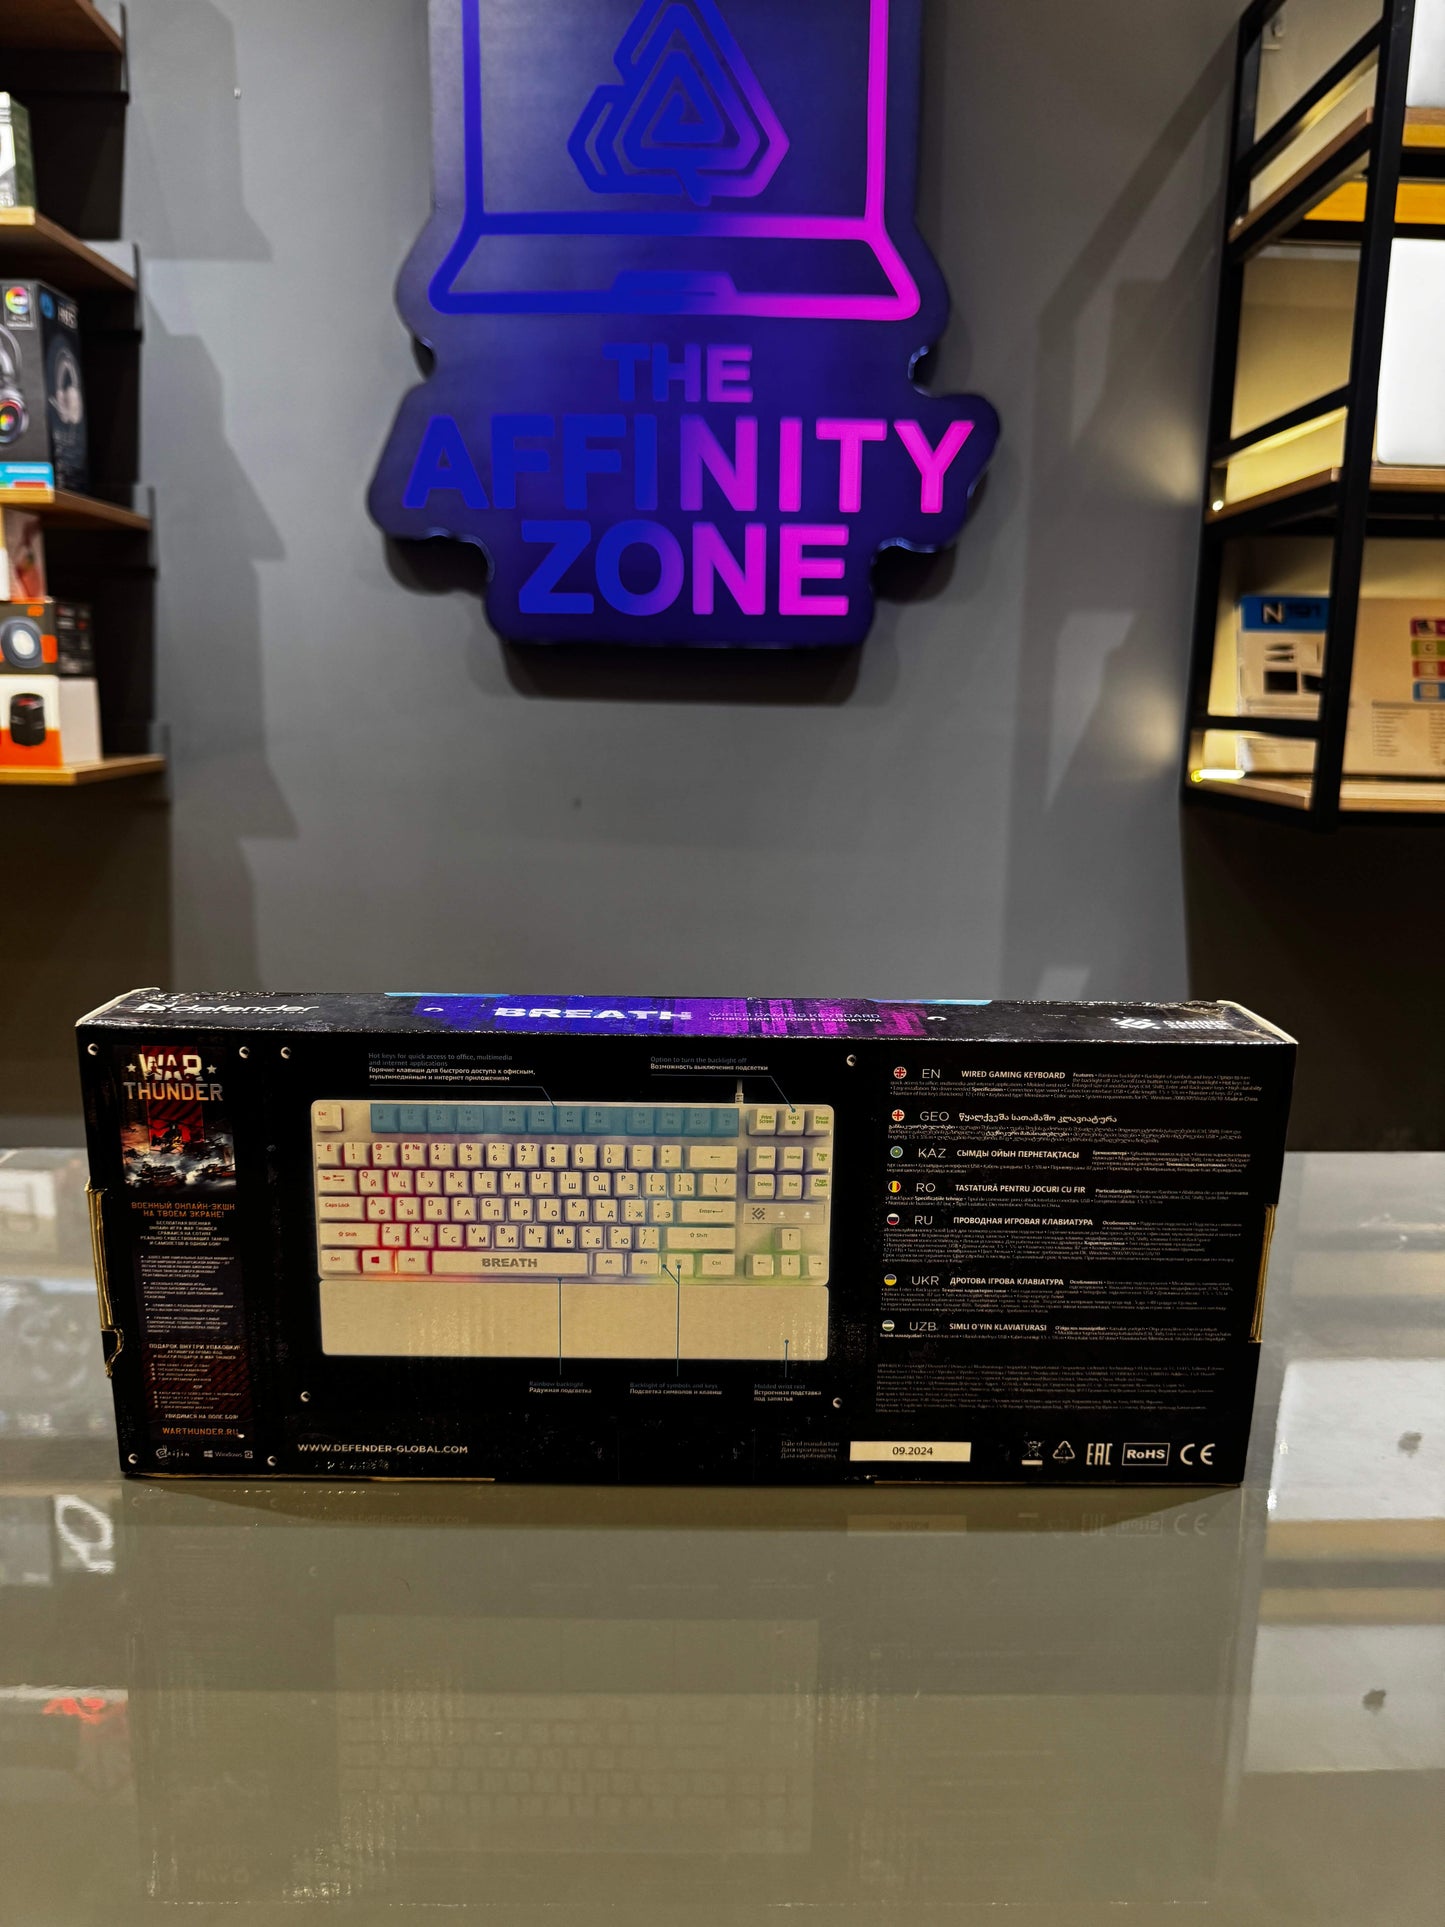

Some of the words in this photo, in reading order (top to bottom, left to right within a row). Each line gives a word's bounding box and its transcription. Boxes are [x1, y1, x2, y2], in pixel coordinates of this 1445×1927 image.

[602, 343, 752, 404] THE
[403, 416, 976, 514] AFFINITY
[518, 520, 851, 617] ZONE
[172, 1003, 319, 1012] defender
[495, 1007, 691, 1020] BREATH
[138, 1054, 203, 1081] WAR
[440, 1067, 469, 1075] быстрого
[922, 1069, 940, 1079] EN
[123, 1082, 223, 1101] THUNDER
[920, 1111, 949, 1121] GEO
[918, 1148, 946, 1158] KAZ
[956, 1150, 988, 1158] СЫМДЫ
[991, 1148, 1016, 1158] ОЙЫН
[916, 1183, 935, 1193] RO
[1032, 1185, 1059, 1193] JOCURI
[132, 1201, 172, 1209] ВОЕННЫЙ
[175, 1202, 235, 1210] ОНЛАЙН-ЭКШН
[915, 1215, 933, 1225] RU
[954, 1217, 1002, 1226] ПРОВОДНАЯ
[1042, 1218, 1093, 1226] КЛАВИАТУРА
[482, 1258, 537, 1268] BREATH
[912, 1276, 939, 1286] UKR
[950, 1277, 986, 1286] ДРОТОВА
[989, 1277, 1014, 1286] ІГРОВА
[1016, 1278, 1064, 1286] КЛАВІАТУРА
[909, 1322, 936, 1332] UZB
[949, 1323, 970, 1331] SIMLI
[995, 1324, 1047, 1332] KLAVIATURASI
[162, 1427, 239, 1435] WARTHUNDER.RU
[297, 1443, 468, 1454] WWW.DEFENDER-GLOBAL.COM
[892, 1446, 933, 1456] 09.2024
[1086, 1443, 1113, 1465] EAC
[1126, 1450, 1166, 1459] RoHS
[1180, 1443, 1215, 1465] CE
